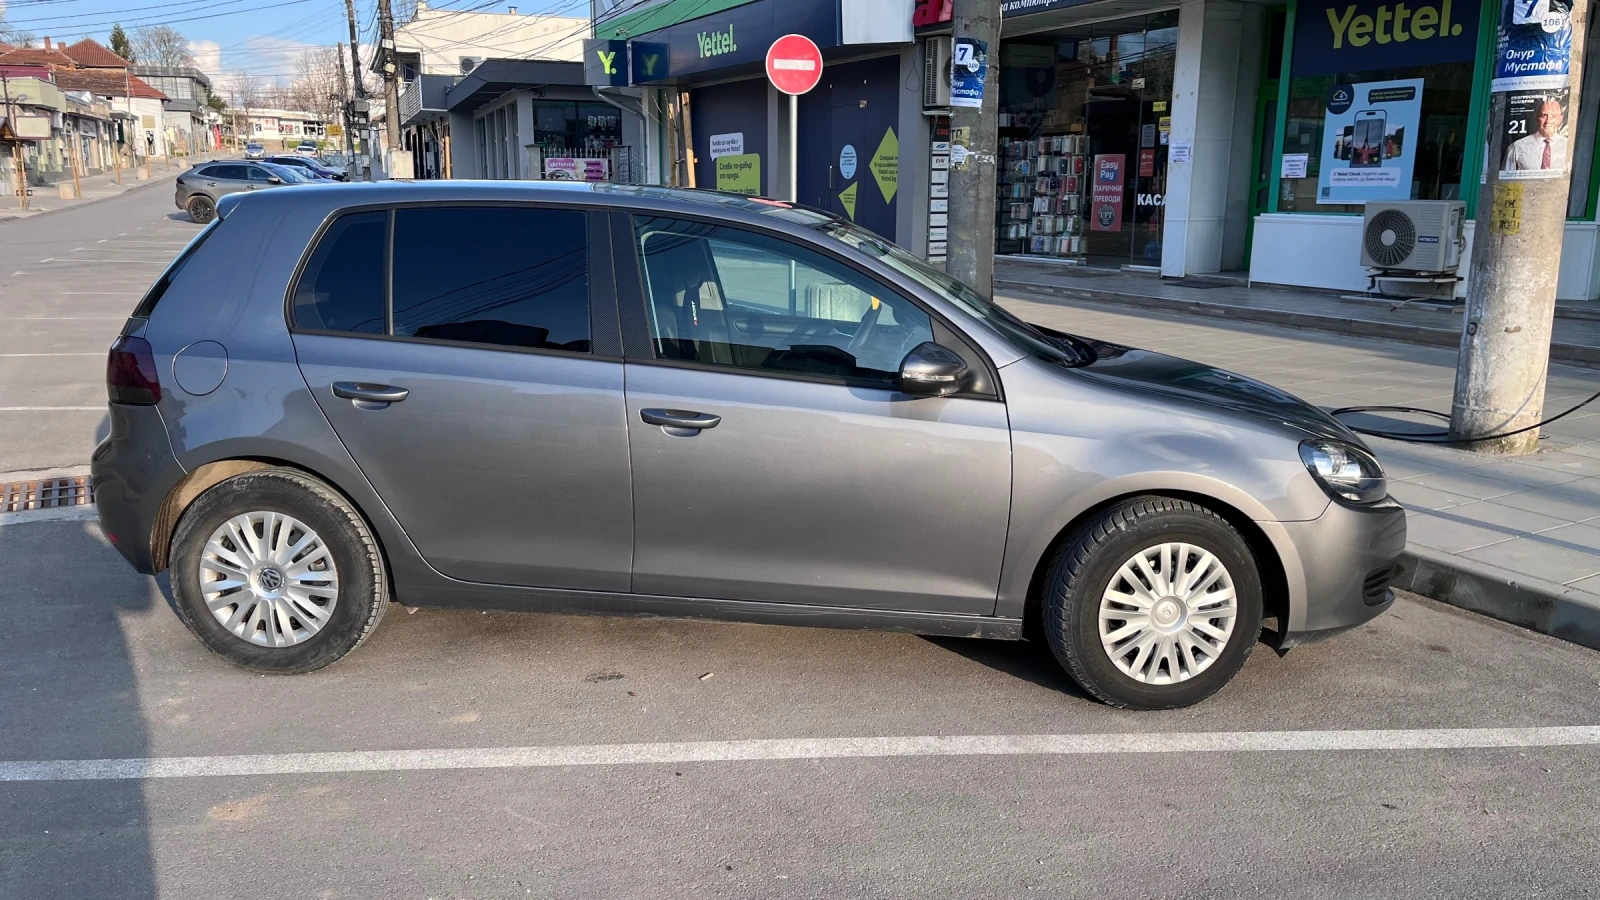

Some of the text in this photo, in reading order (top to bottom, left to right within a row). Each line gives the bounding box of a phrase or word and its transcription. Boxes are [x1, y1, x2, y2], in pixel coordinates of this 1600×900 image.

[1325, 0, 1463, 49] Yettel.
[1543, 18, 1561, 27] 106
[696, 24, 737, 58] Yettel.
[959, 47, 968, 61] 7
[1506, 49, 1535, 60] Онур
[597, 50, 617, 75] Y.
[1504, 60, 1562, 73] Мустафа
[1508, 119, 1527, 134] 21
[1101, 160, 1118, 170] Easy
[1100, 170, 1114, 180] Pay
[1094, 184, 1122, 192] ПАРИЧНИ
[1094, 195, 1121, 204] ПРЕВОДИ
